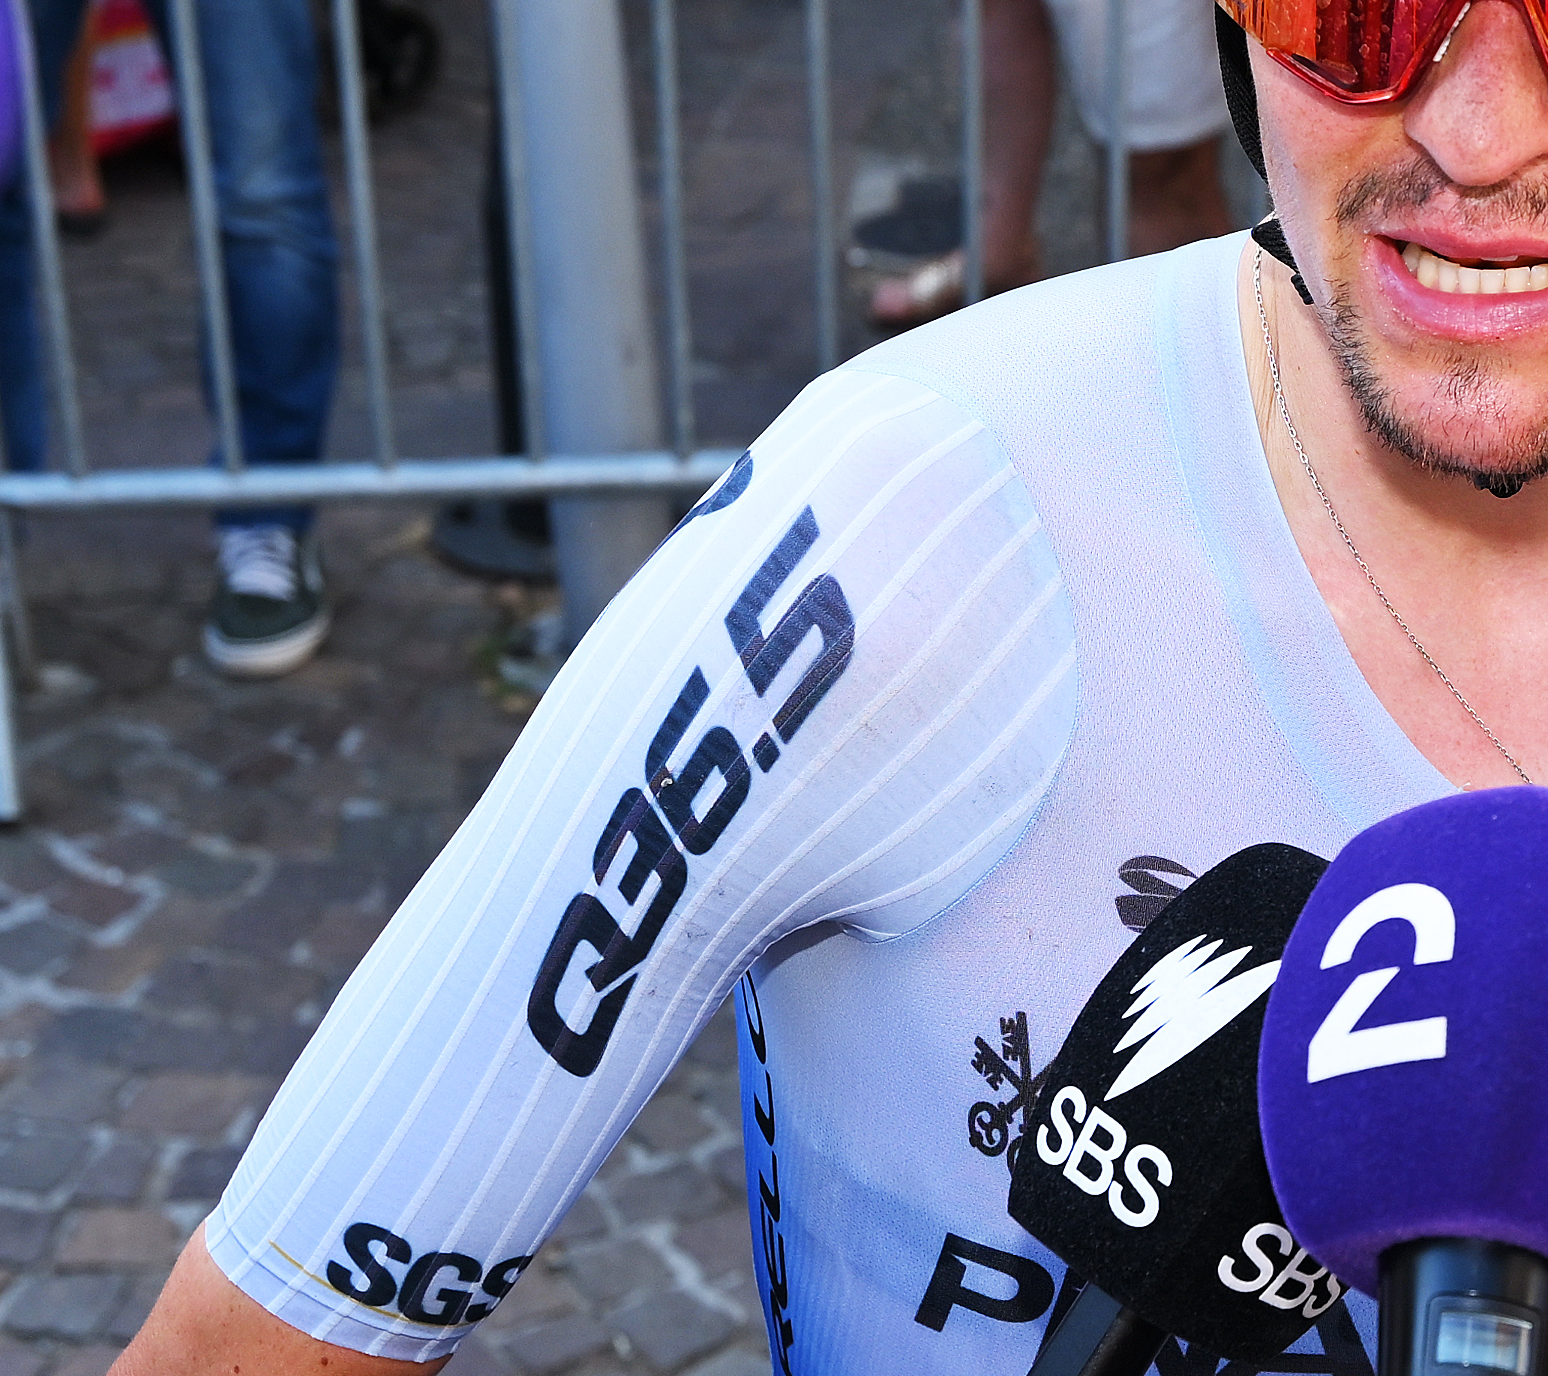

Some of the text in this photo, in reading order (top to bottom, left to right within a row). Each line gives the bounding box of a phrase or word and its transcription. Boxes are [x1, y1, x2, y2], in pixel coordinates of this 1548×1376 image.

[527, 505, 856, 1078] Q36.5
[1306, 881, 1456, 1084] 2
[1036, 1085, 1174, 1229] SBS
[326, 1222, 534, 1325] SGS
[1217, 1222, 1342, 1319] SBS
